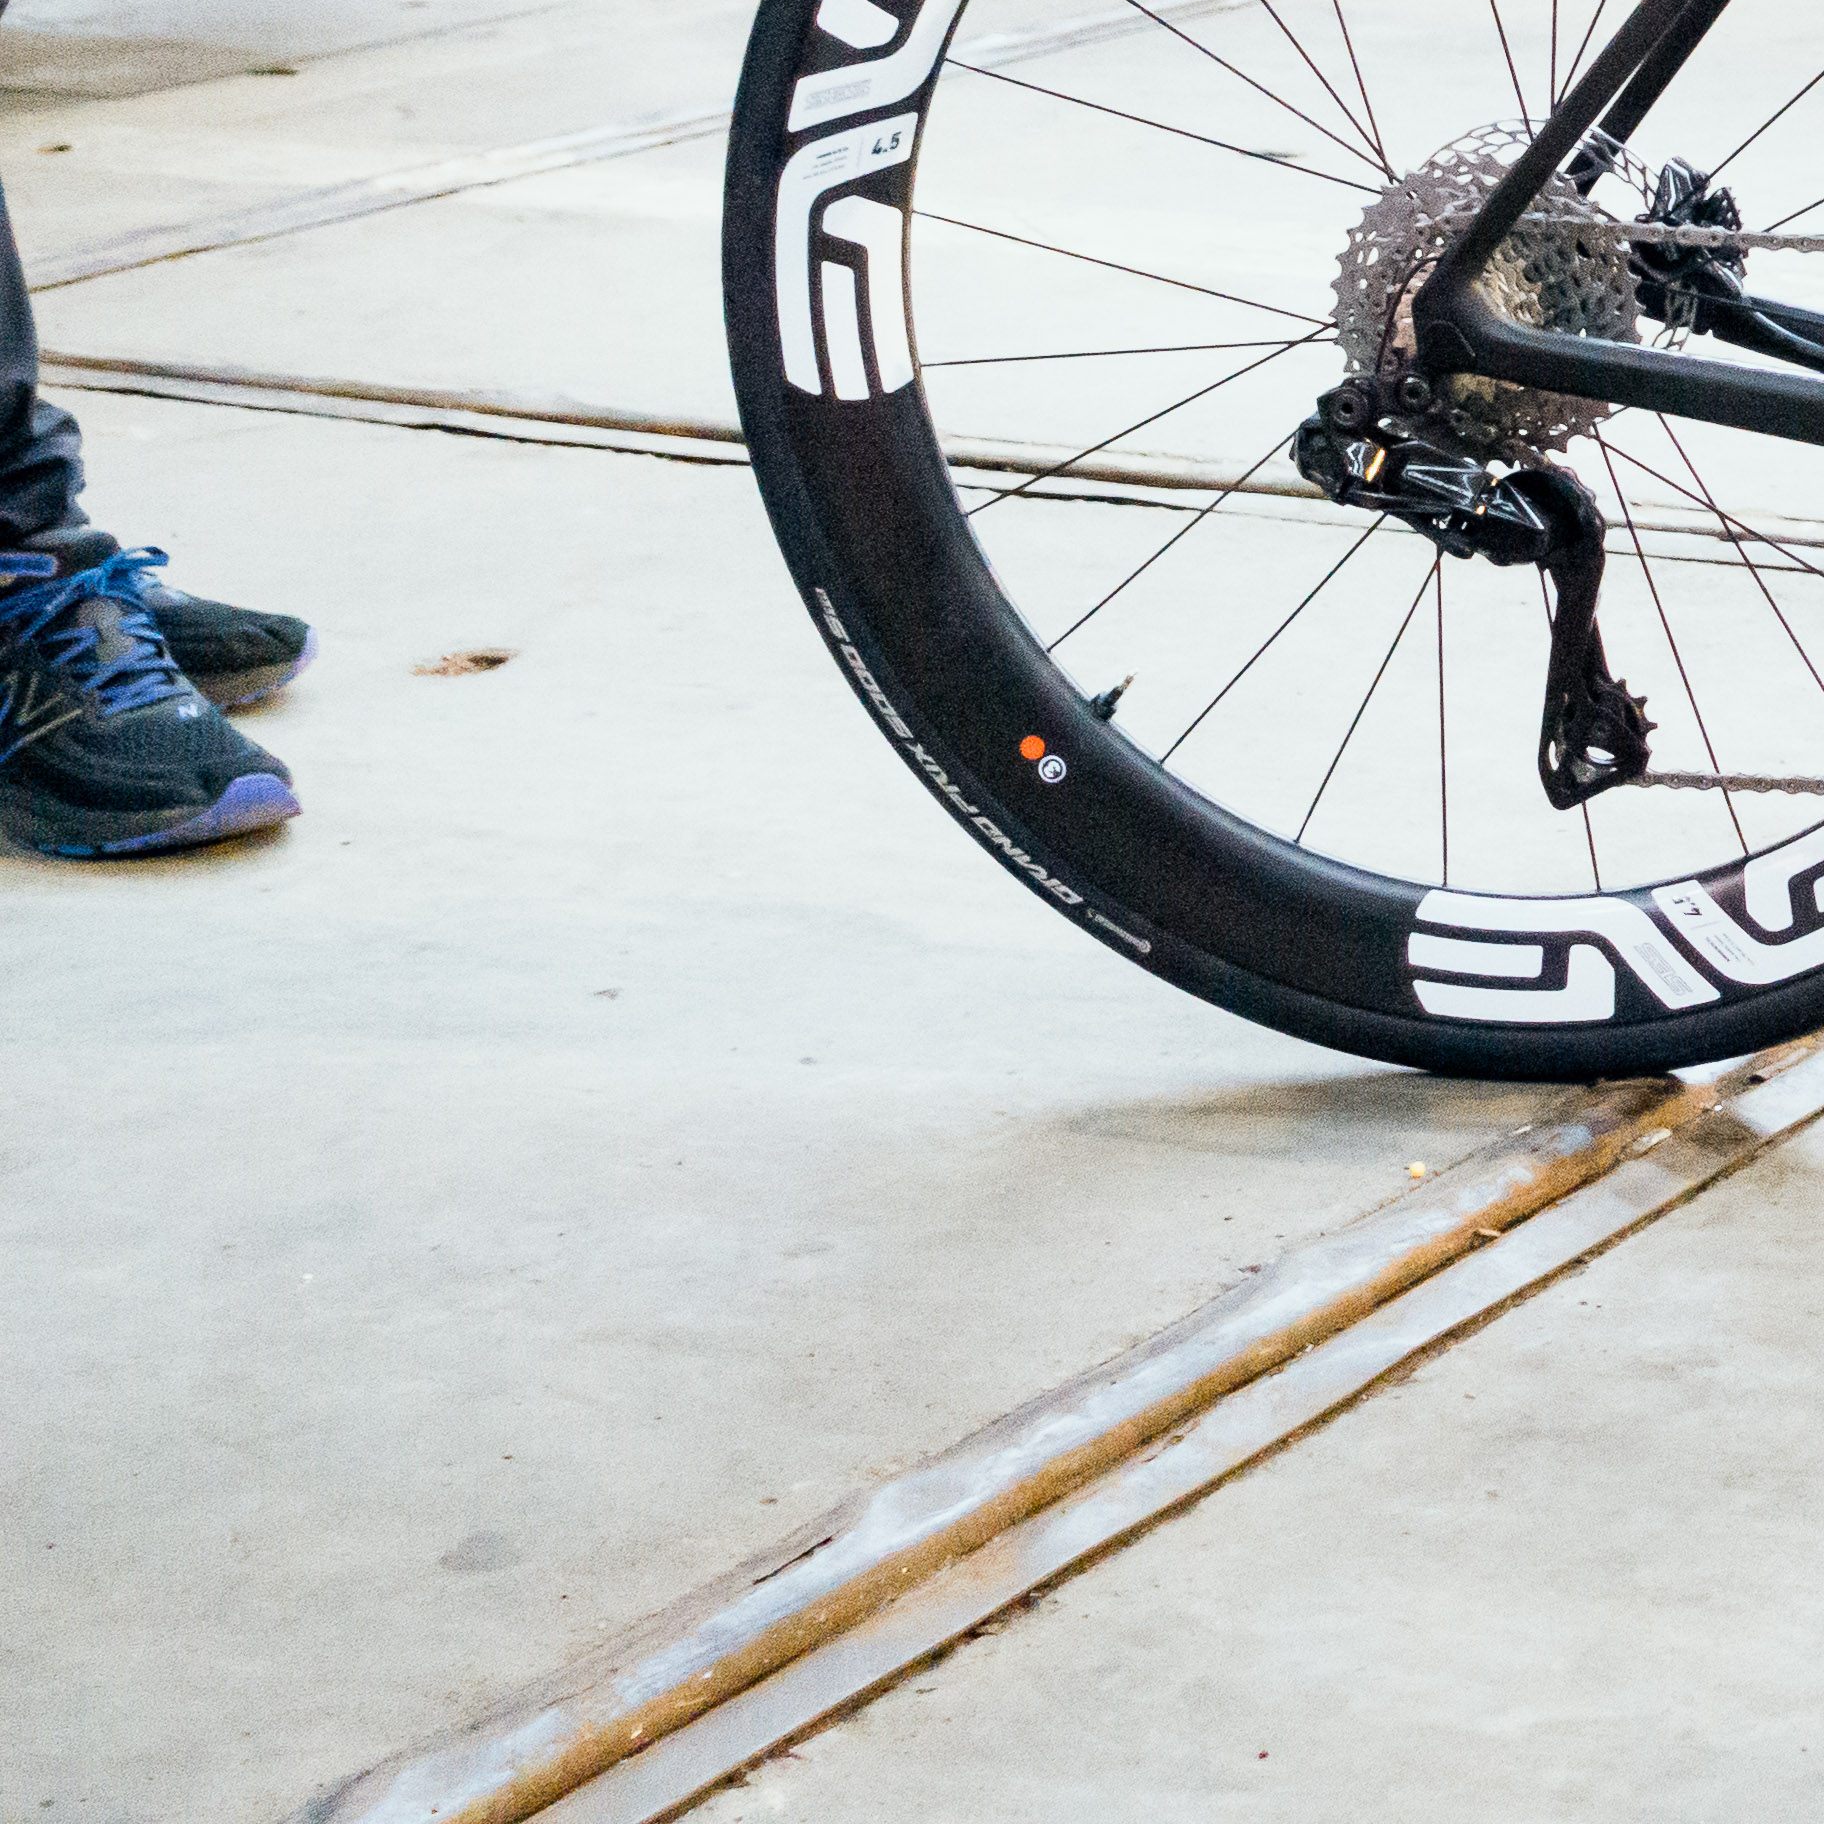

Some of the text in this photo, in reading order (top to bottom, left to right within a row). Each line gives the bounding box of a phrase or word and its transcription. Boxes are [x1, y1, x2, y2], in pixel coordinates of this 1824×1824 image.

[871, 131, 902, 155] 4.5
[905, 741, 981, 815] PRIX
[970, 814, 1085, 906] GRAND
